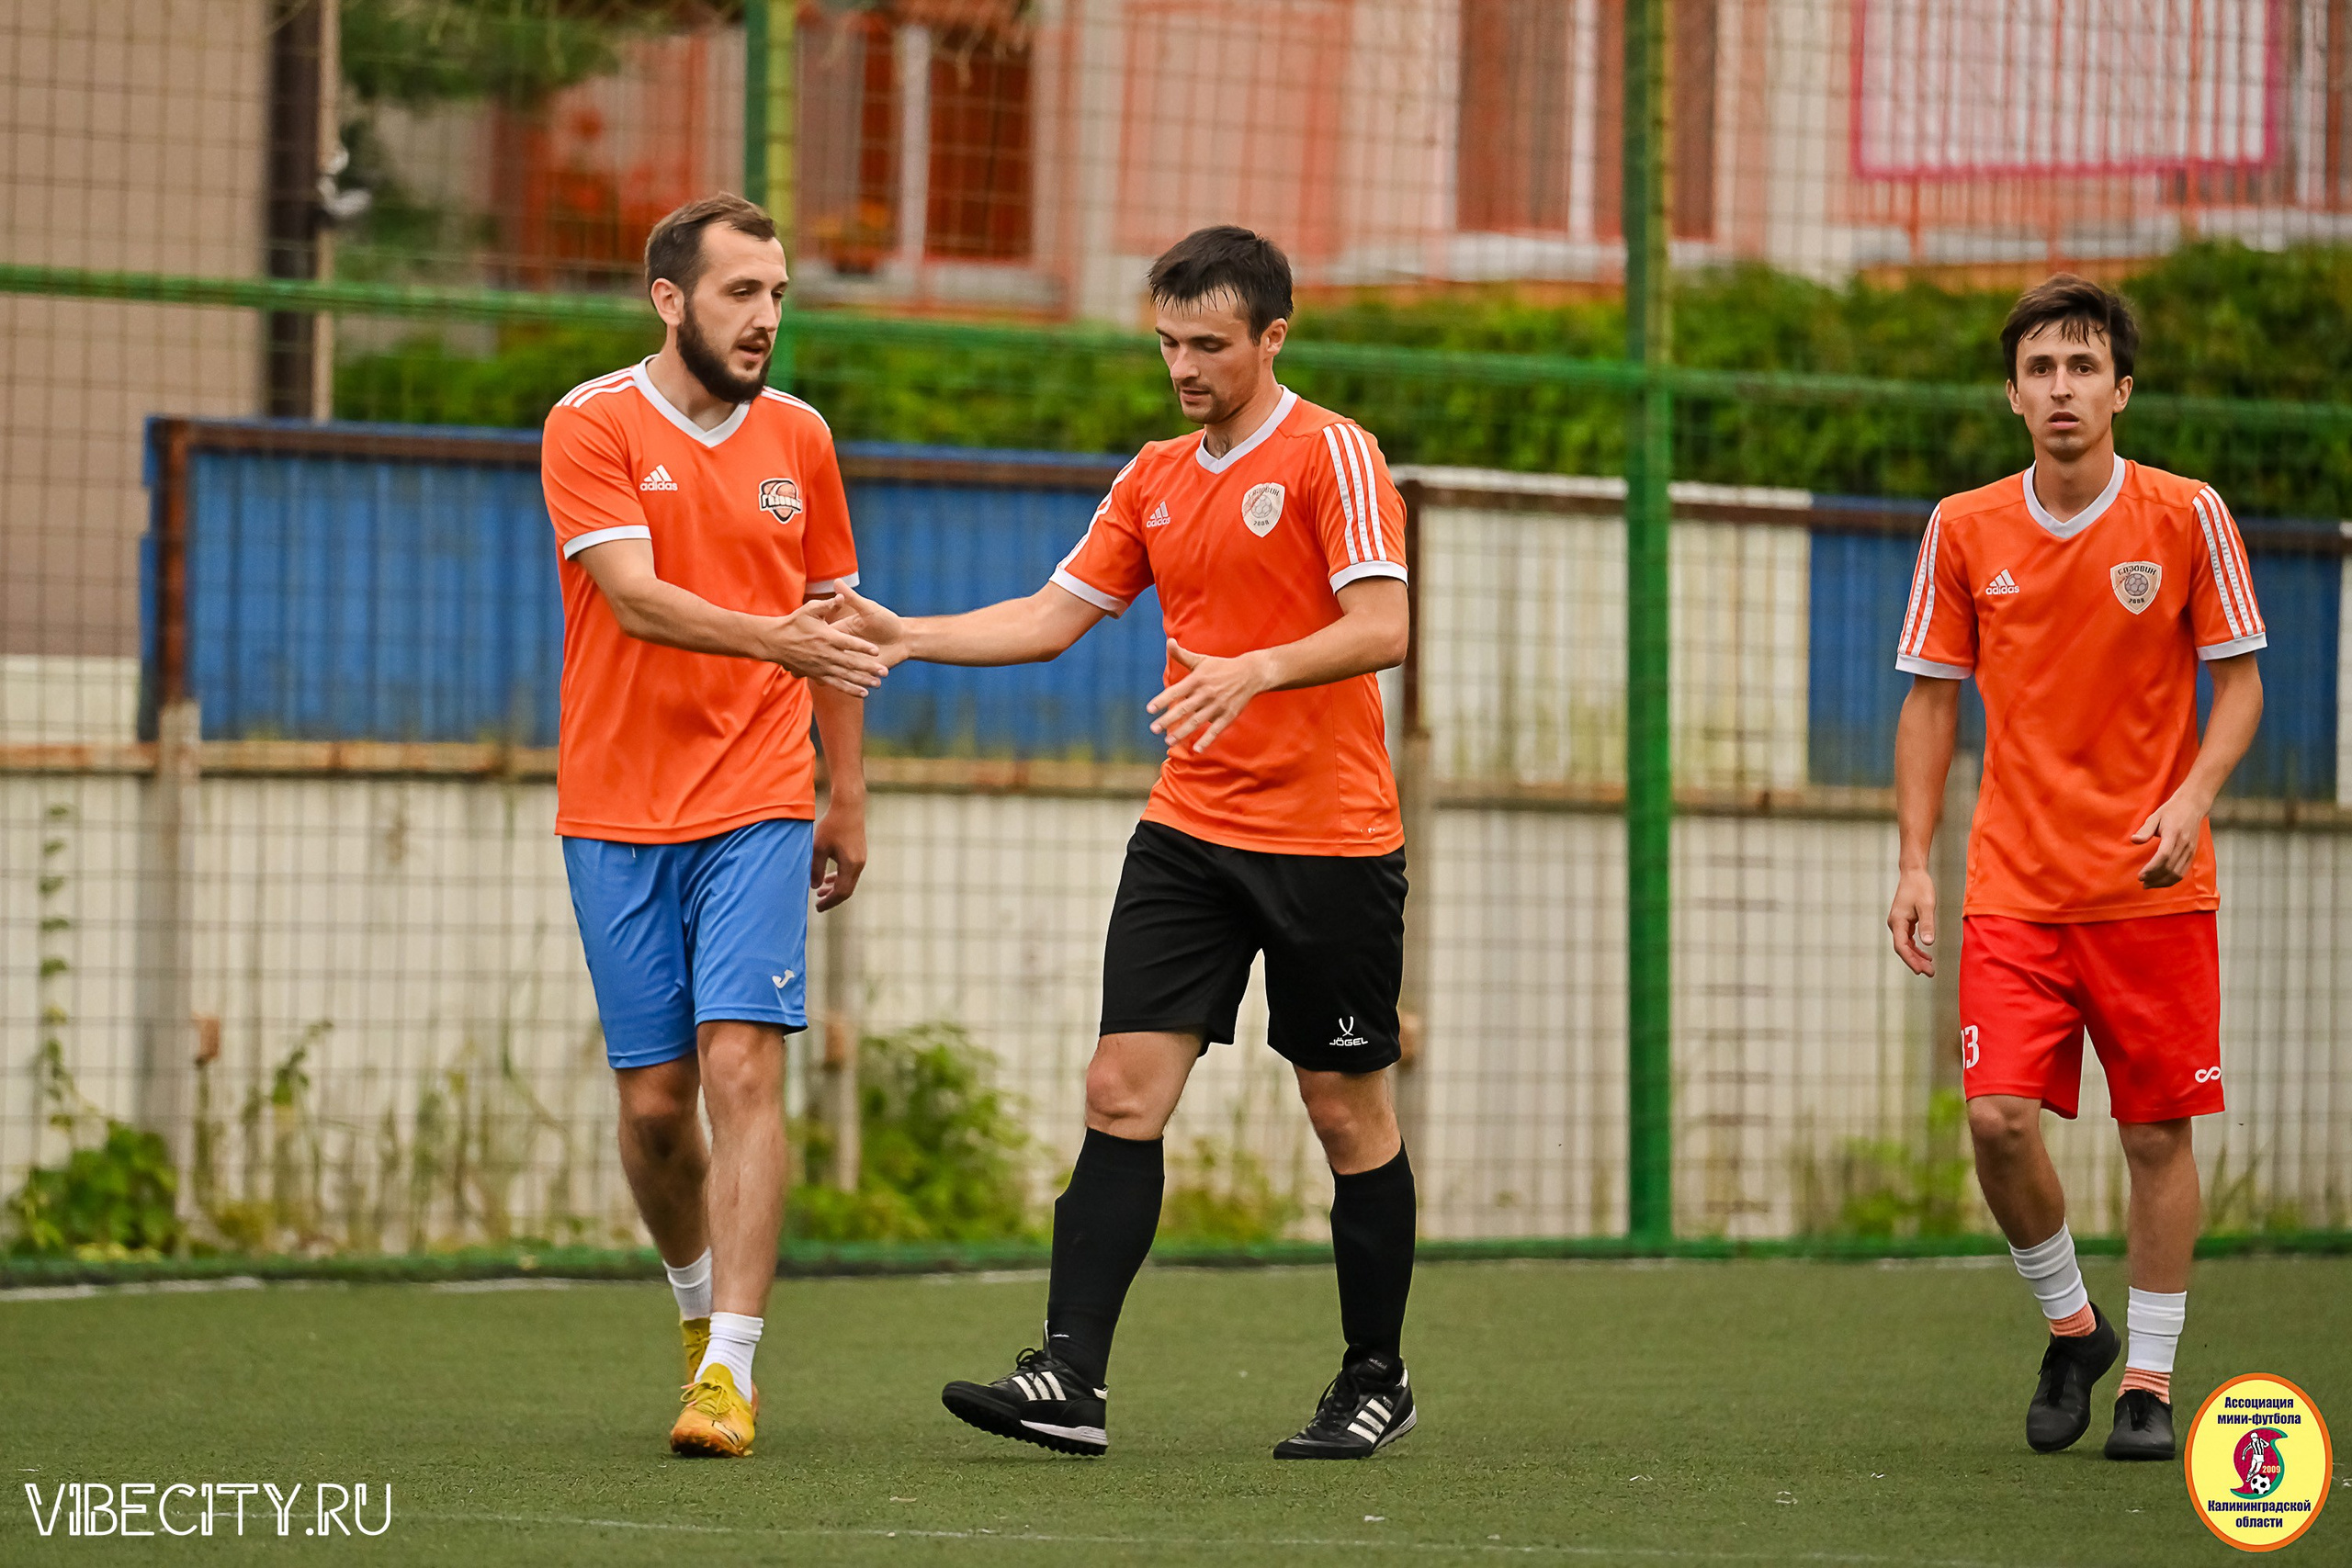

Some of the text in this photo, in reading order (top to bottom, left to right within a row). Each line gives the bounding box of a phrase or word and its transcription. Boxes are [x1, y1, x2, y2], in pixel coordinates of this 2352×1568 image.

[639, 480, 678, 491] adidas
[1146, 517, 1171, 528] adidas
[1985, 585, 2019, 595] adidas
[1329, 1037, 1369, 1046] JÖGEL
